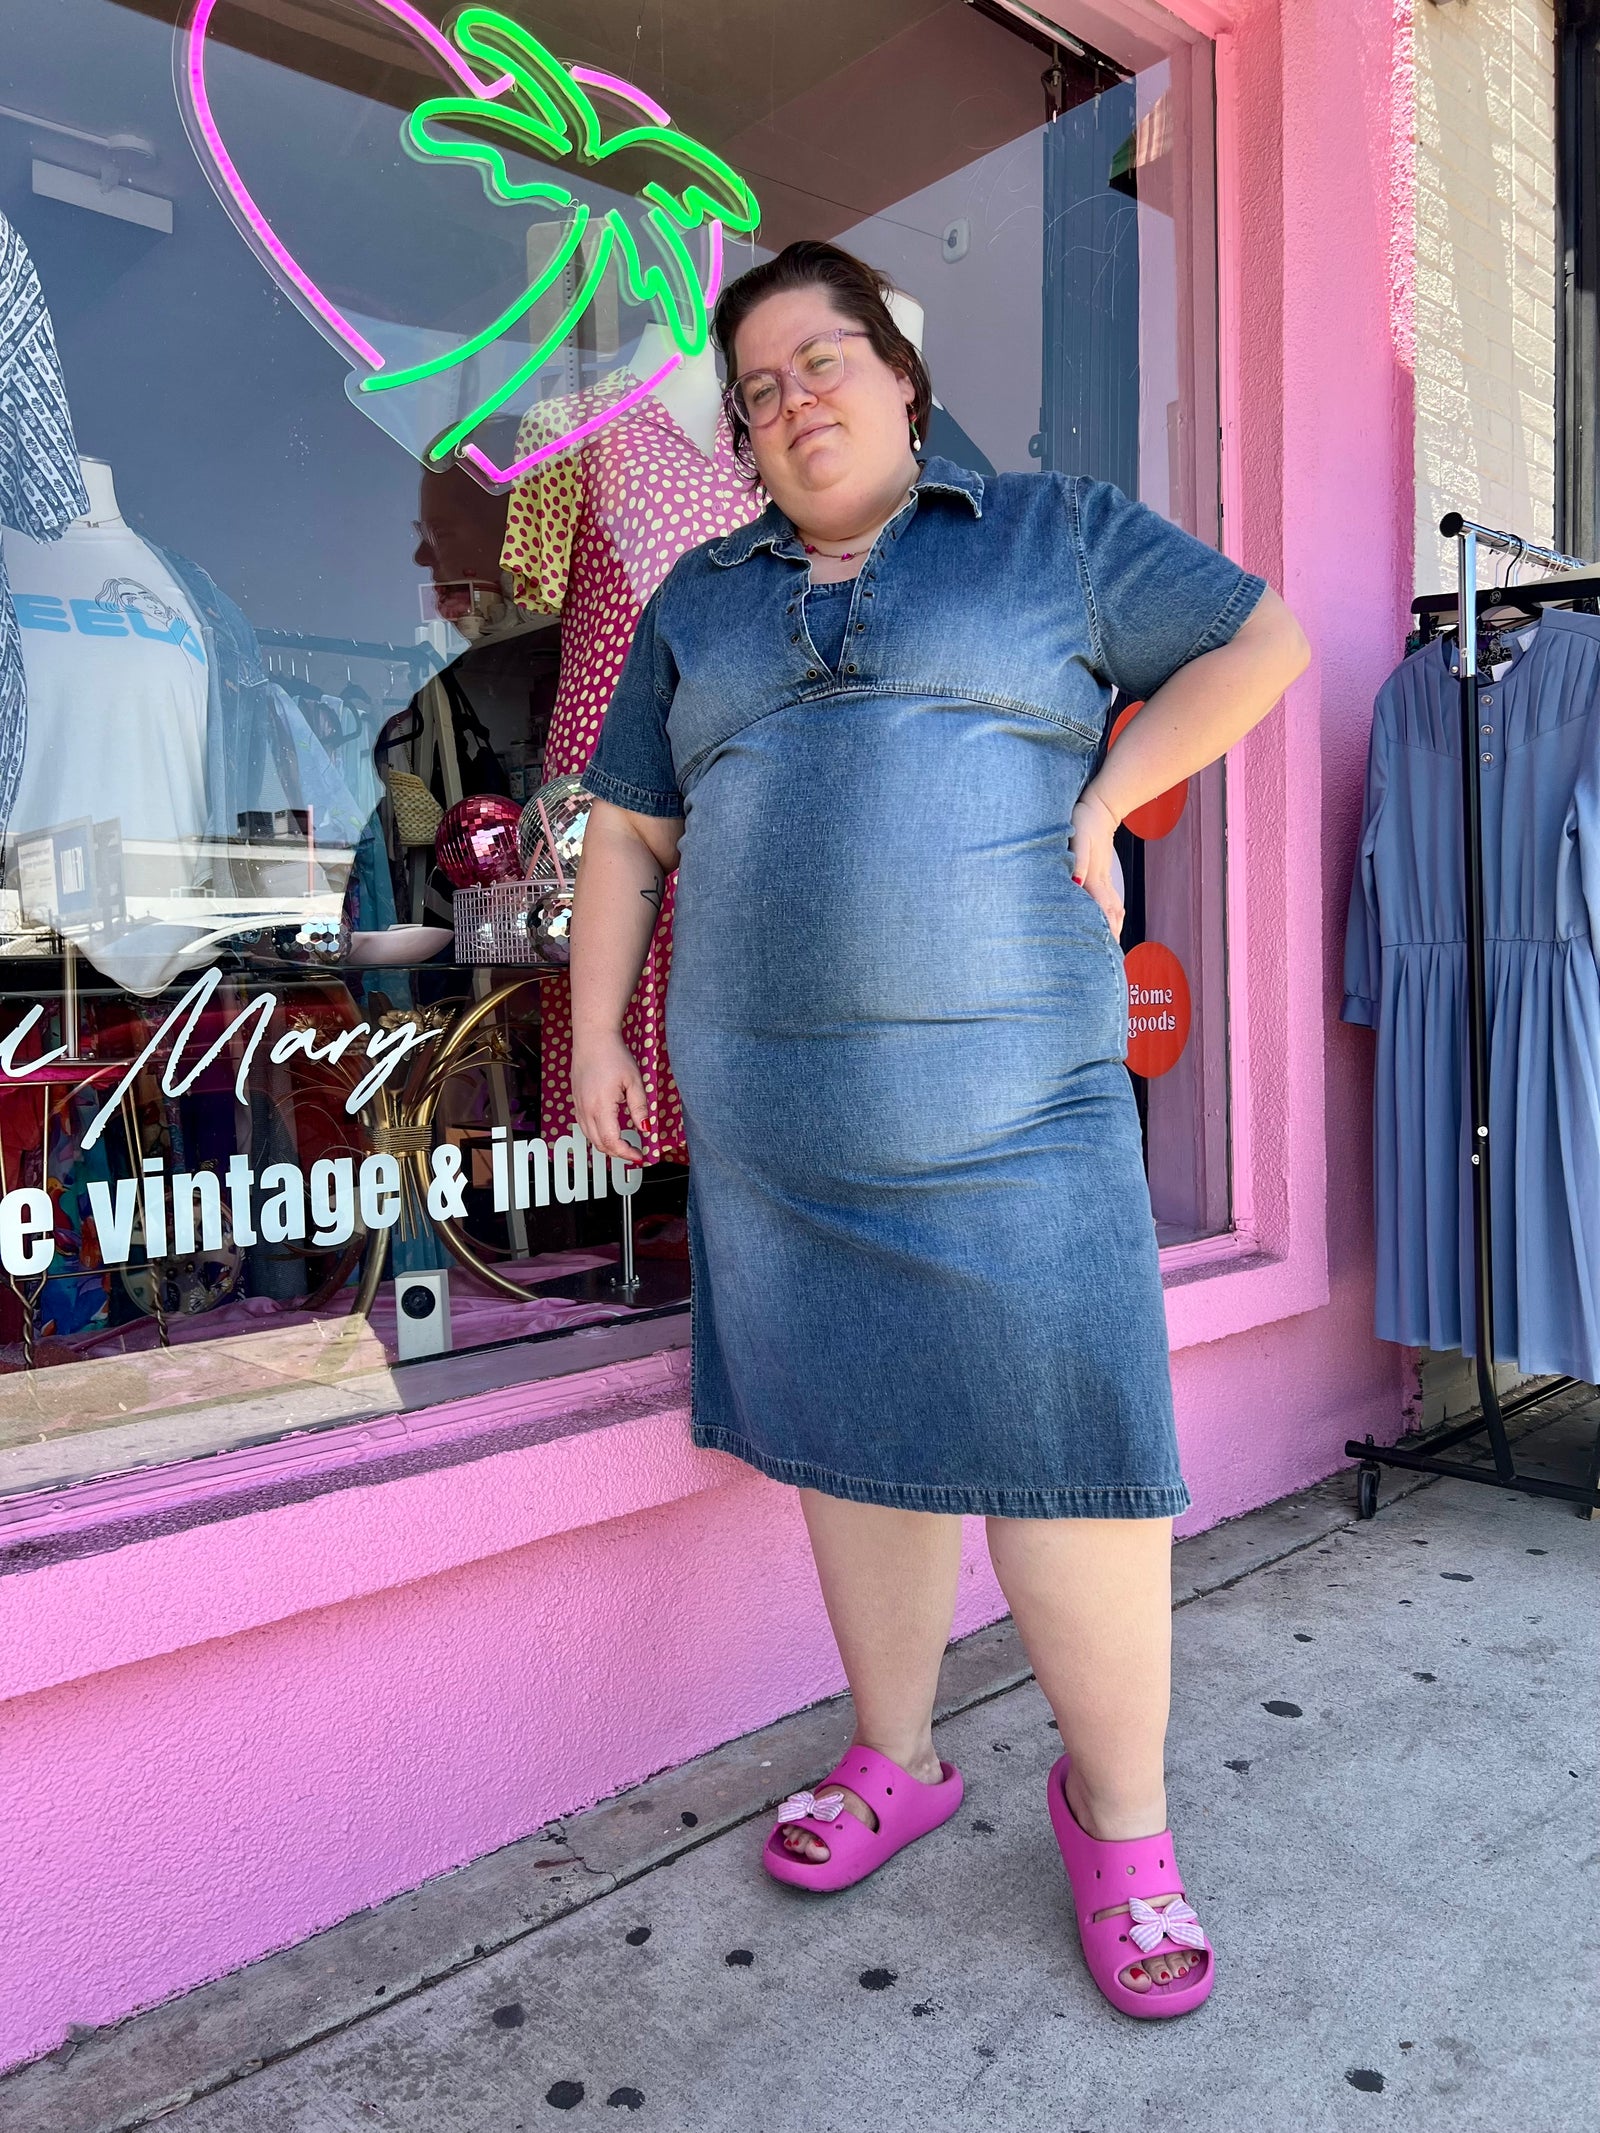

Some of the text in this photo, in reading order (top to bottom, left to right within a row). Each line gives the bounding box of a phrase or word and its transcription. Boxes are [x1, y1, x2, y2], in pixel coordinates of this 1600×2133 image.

[1128, 1010, 1176, 1038] goods
[1129, 984, 1173, 1005] Home
[80, 967, 443, 1149] Mary
[87, 1153, 401, 1264] vintage
[427, 1143, 469, 1222] &
